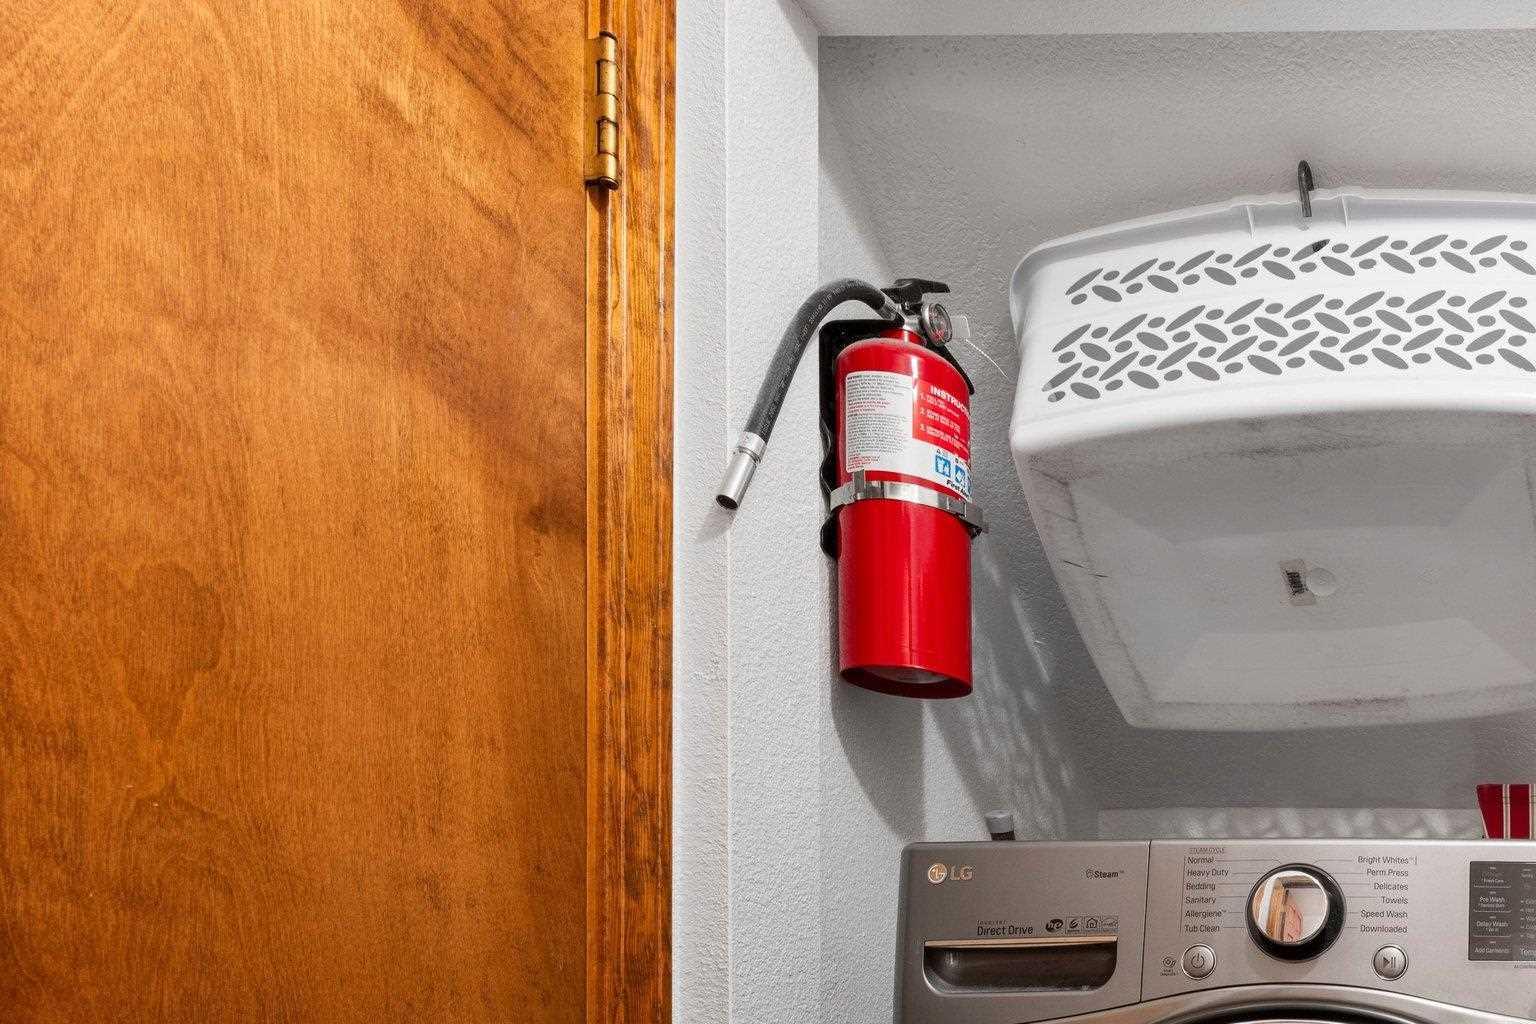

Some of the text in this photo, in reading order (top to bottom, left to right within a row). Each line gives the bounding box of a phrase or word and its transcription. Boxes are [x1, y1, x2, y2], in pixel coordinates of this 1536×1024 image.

[1358, 855, 1381, 865] Bright
[1187, 869, 1229, 877] Heavy Duty
[1366, 868, 1409, 877] Perm Press
[1186, 882, 1216, 890] Bedding
[1374, 882, 1409, 891] Delicates
[1185, 896, 1216, 904] Sanitary
[1381, 896, 1409, 904] Towels
[1184, 909, 1222, 919] Allergiene
[1360, 909, 1408, 918] Speed Wash
[977, 924, 1034, 936] Direct Drive
[1185, 924, 1221, 932] Tub Clean
[1360, 924, 1408, 933] Downloaded
